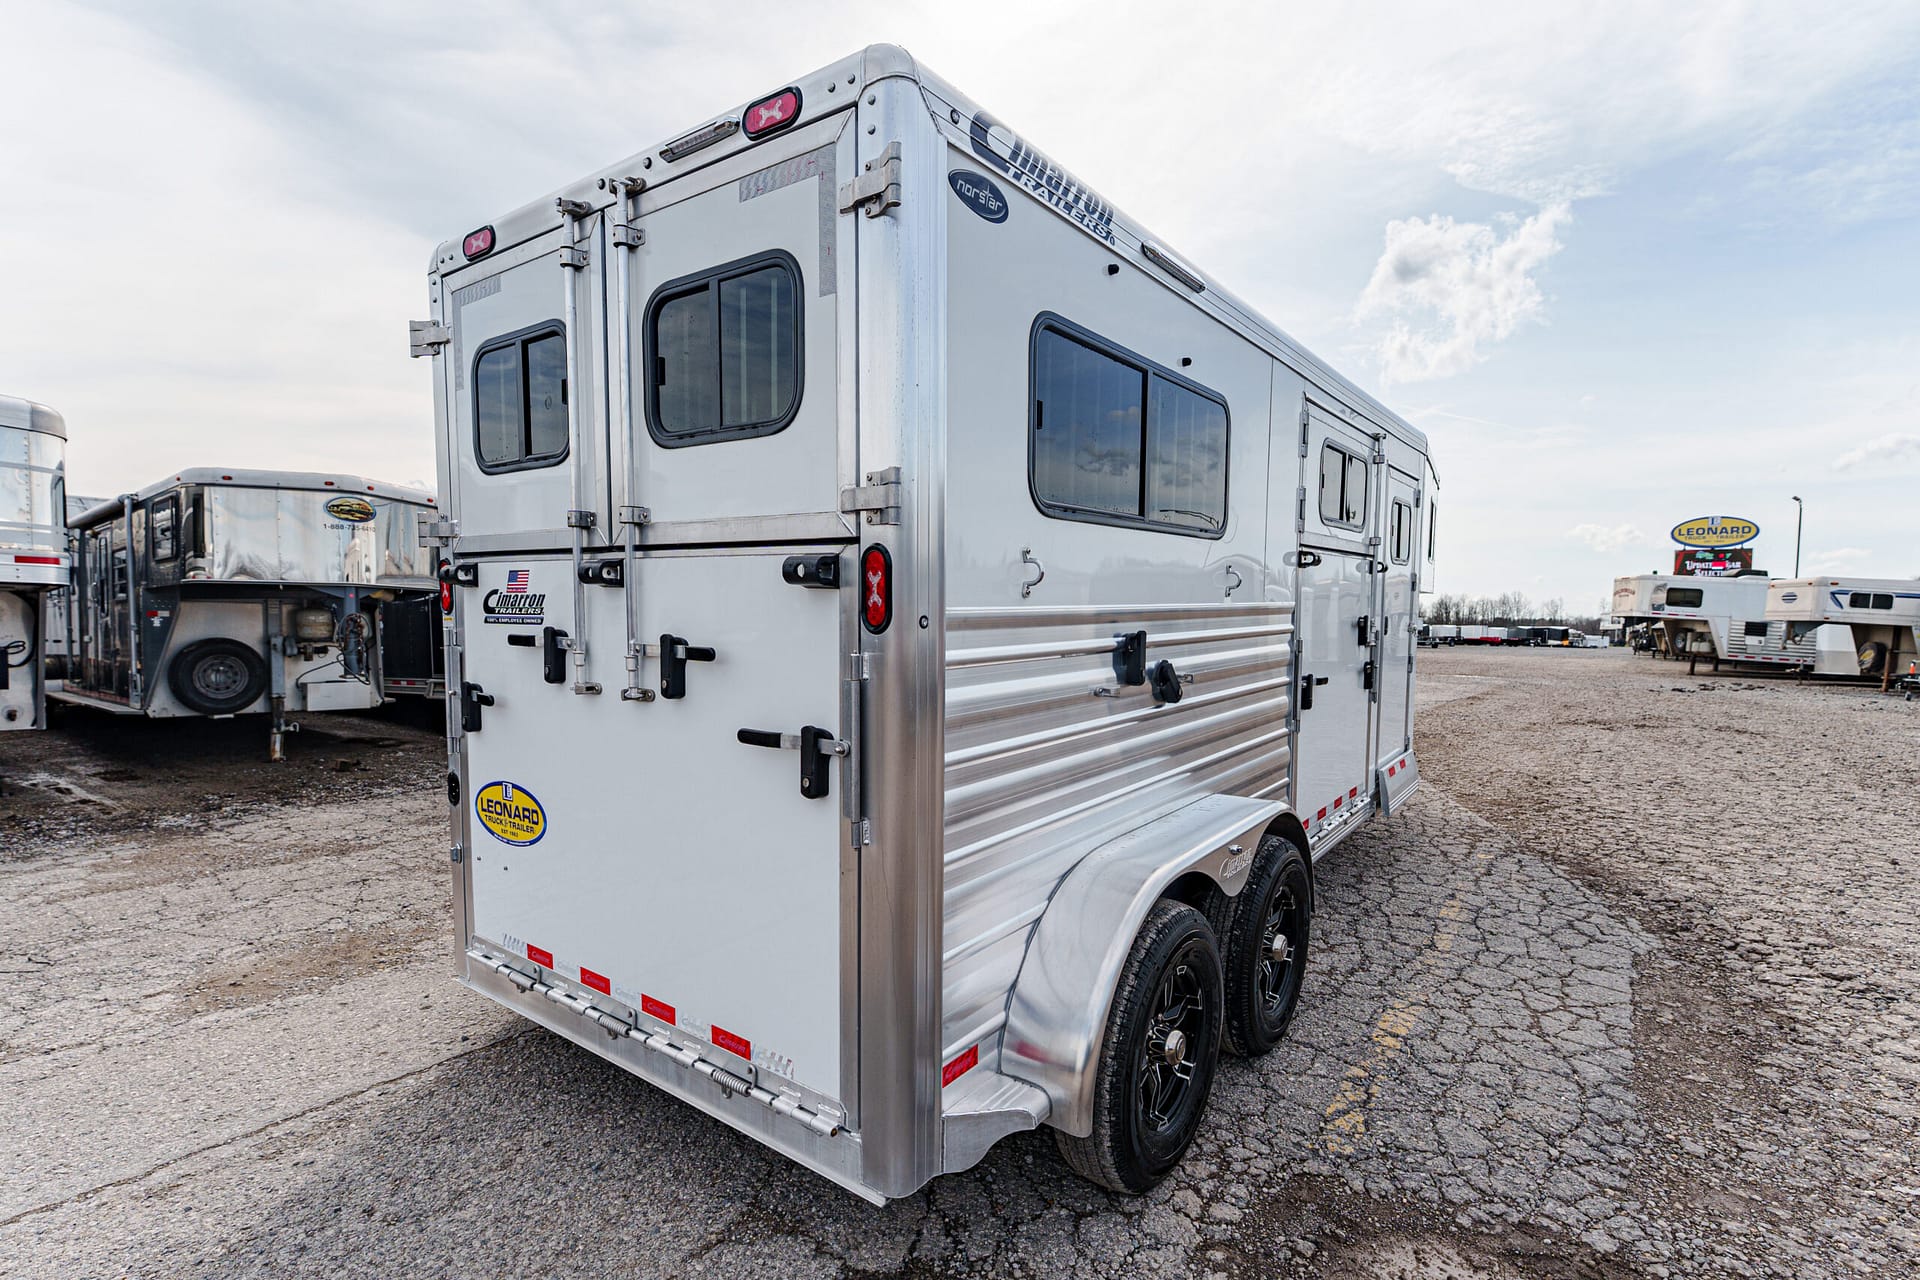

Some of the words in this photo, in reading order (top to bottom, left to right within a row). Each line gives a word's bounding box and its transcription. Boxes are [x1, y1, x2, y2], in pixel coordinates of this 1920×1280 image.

[970, 111, 1115, 228] Cimarron
[956, 180, 1003, 211] norstar
[1006, 162, 1108, 239] TRAILERS
[1678, 526, 1752, 536] LEONARD
[483, 589, 546, 614] Cimarron
[481, 797, 539, 825] LEONARD
[484, 814, 504, 826] TRUCK
[509, 820, 535, 834] TRAILER
